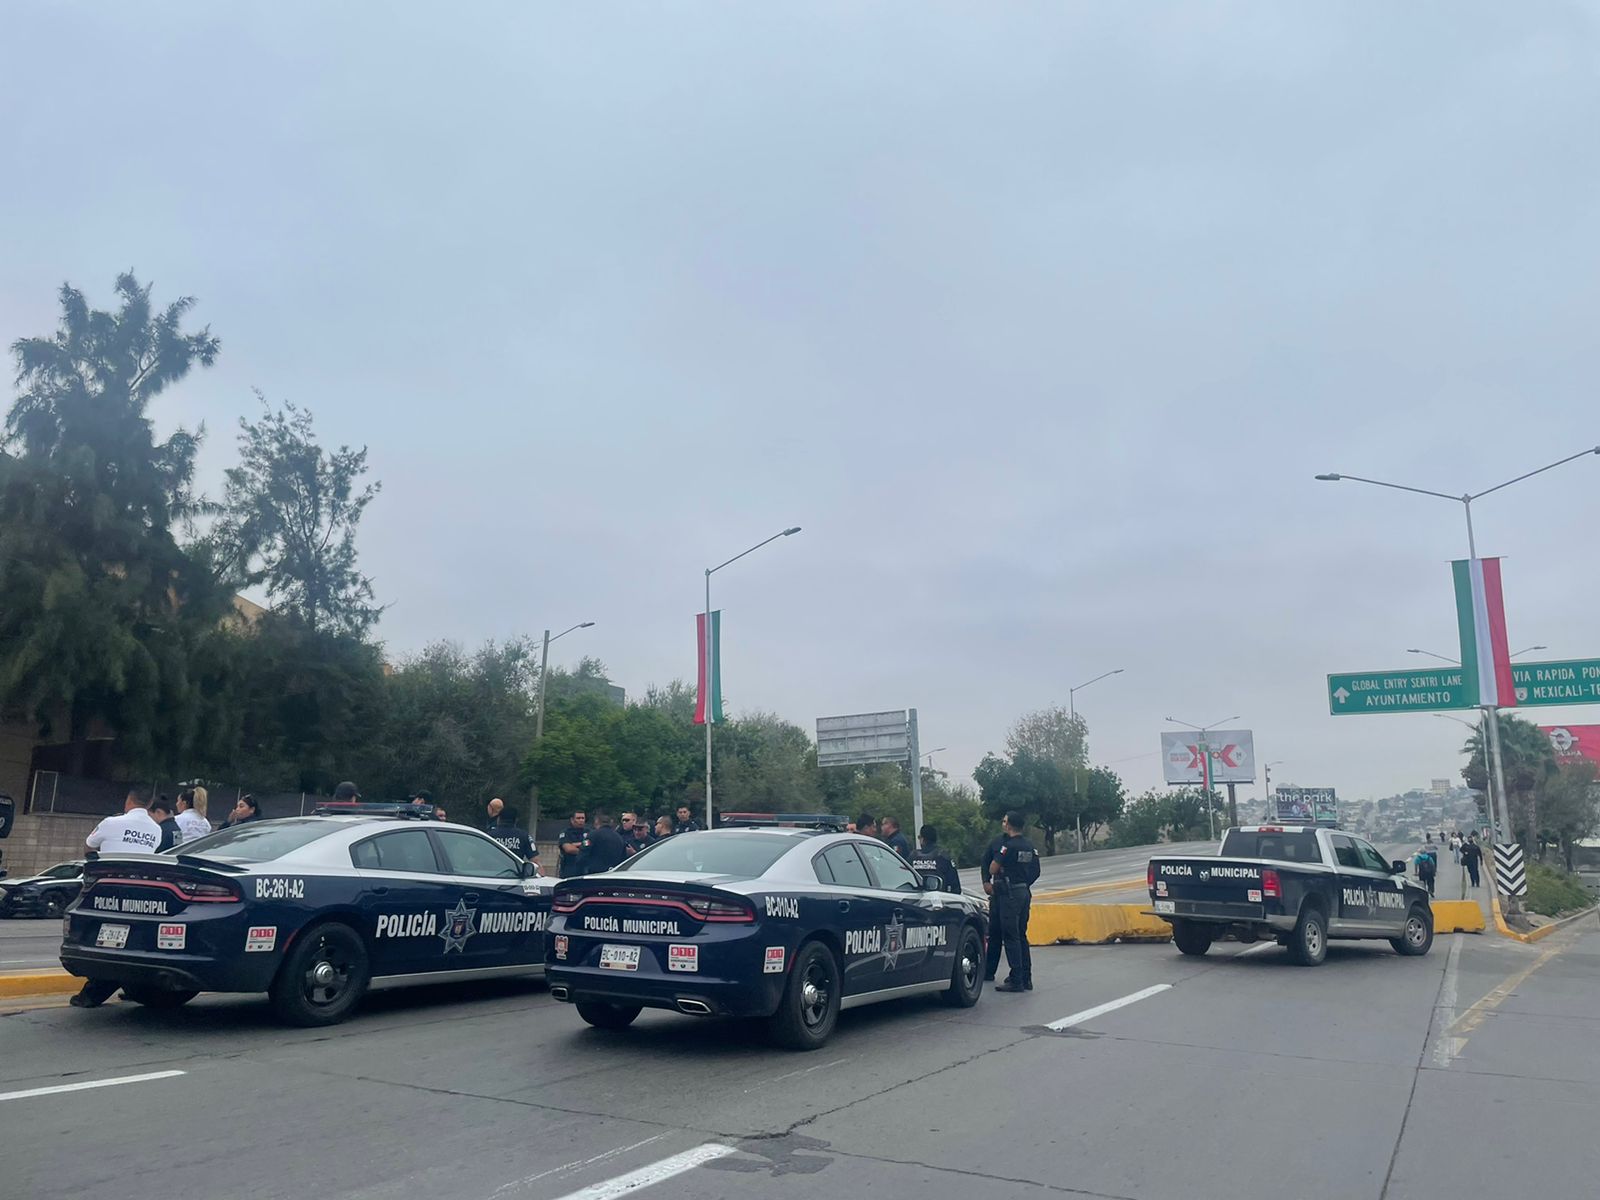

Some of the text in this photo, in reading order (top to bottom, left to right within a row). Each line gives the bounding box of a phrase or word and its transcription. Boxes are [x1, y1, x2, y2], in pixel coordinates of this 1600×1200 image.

[1513, 671, 1531, 682] VIA
[1537, 668, 1576, 681] RAPIDA
[1351, 675, 1462, 691] GLOBAL ENTRY SENTRI LANE
[1366, 691, 1451, 706] AYUNTAMIENTO
[1280, 792, 1332, 804] the park
[122, 837, 154, 848] MUNICIPAL
[124, 829, 156, 842] POLICÍA
[496, 837, 520, 845] OLICÍA
[1160, 864, 1193, 876] POLICÍA
[1211, 867, 1260, 879] MUNICIPAL
[256, 878, 305, 899] BC-261-A2
[1343, 886, 1366, 906] POLICÍA
[94, 896, 168, 914] POLICÍA MUNICIPAL
[765, 895, 799, 918] BC-010-A2
[1378, 891, 1405, 909] MUNICIPAL
[375, 910, 437, 938] POLICÍA
[584, 916, 680, 935] POLICÍA MUNICIPAL
[251, 929, 274, 937] 911
[845, 926, 880, 955] POLICÍA
[905, 926, 947, 949] MUNICIPAL
[602, 949, 637, 962] BC-010-A2
[671, 947, 696, 957] 911
